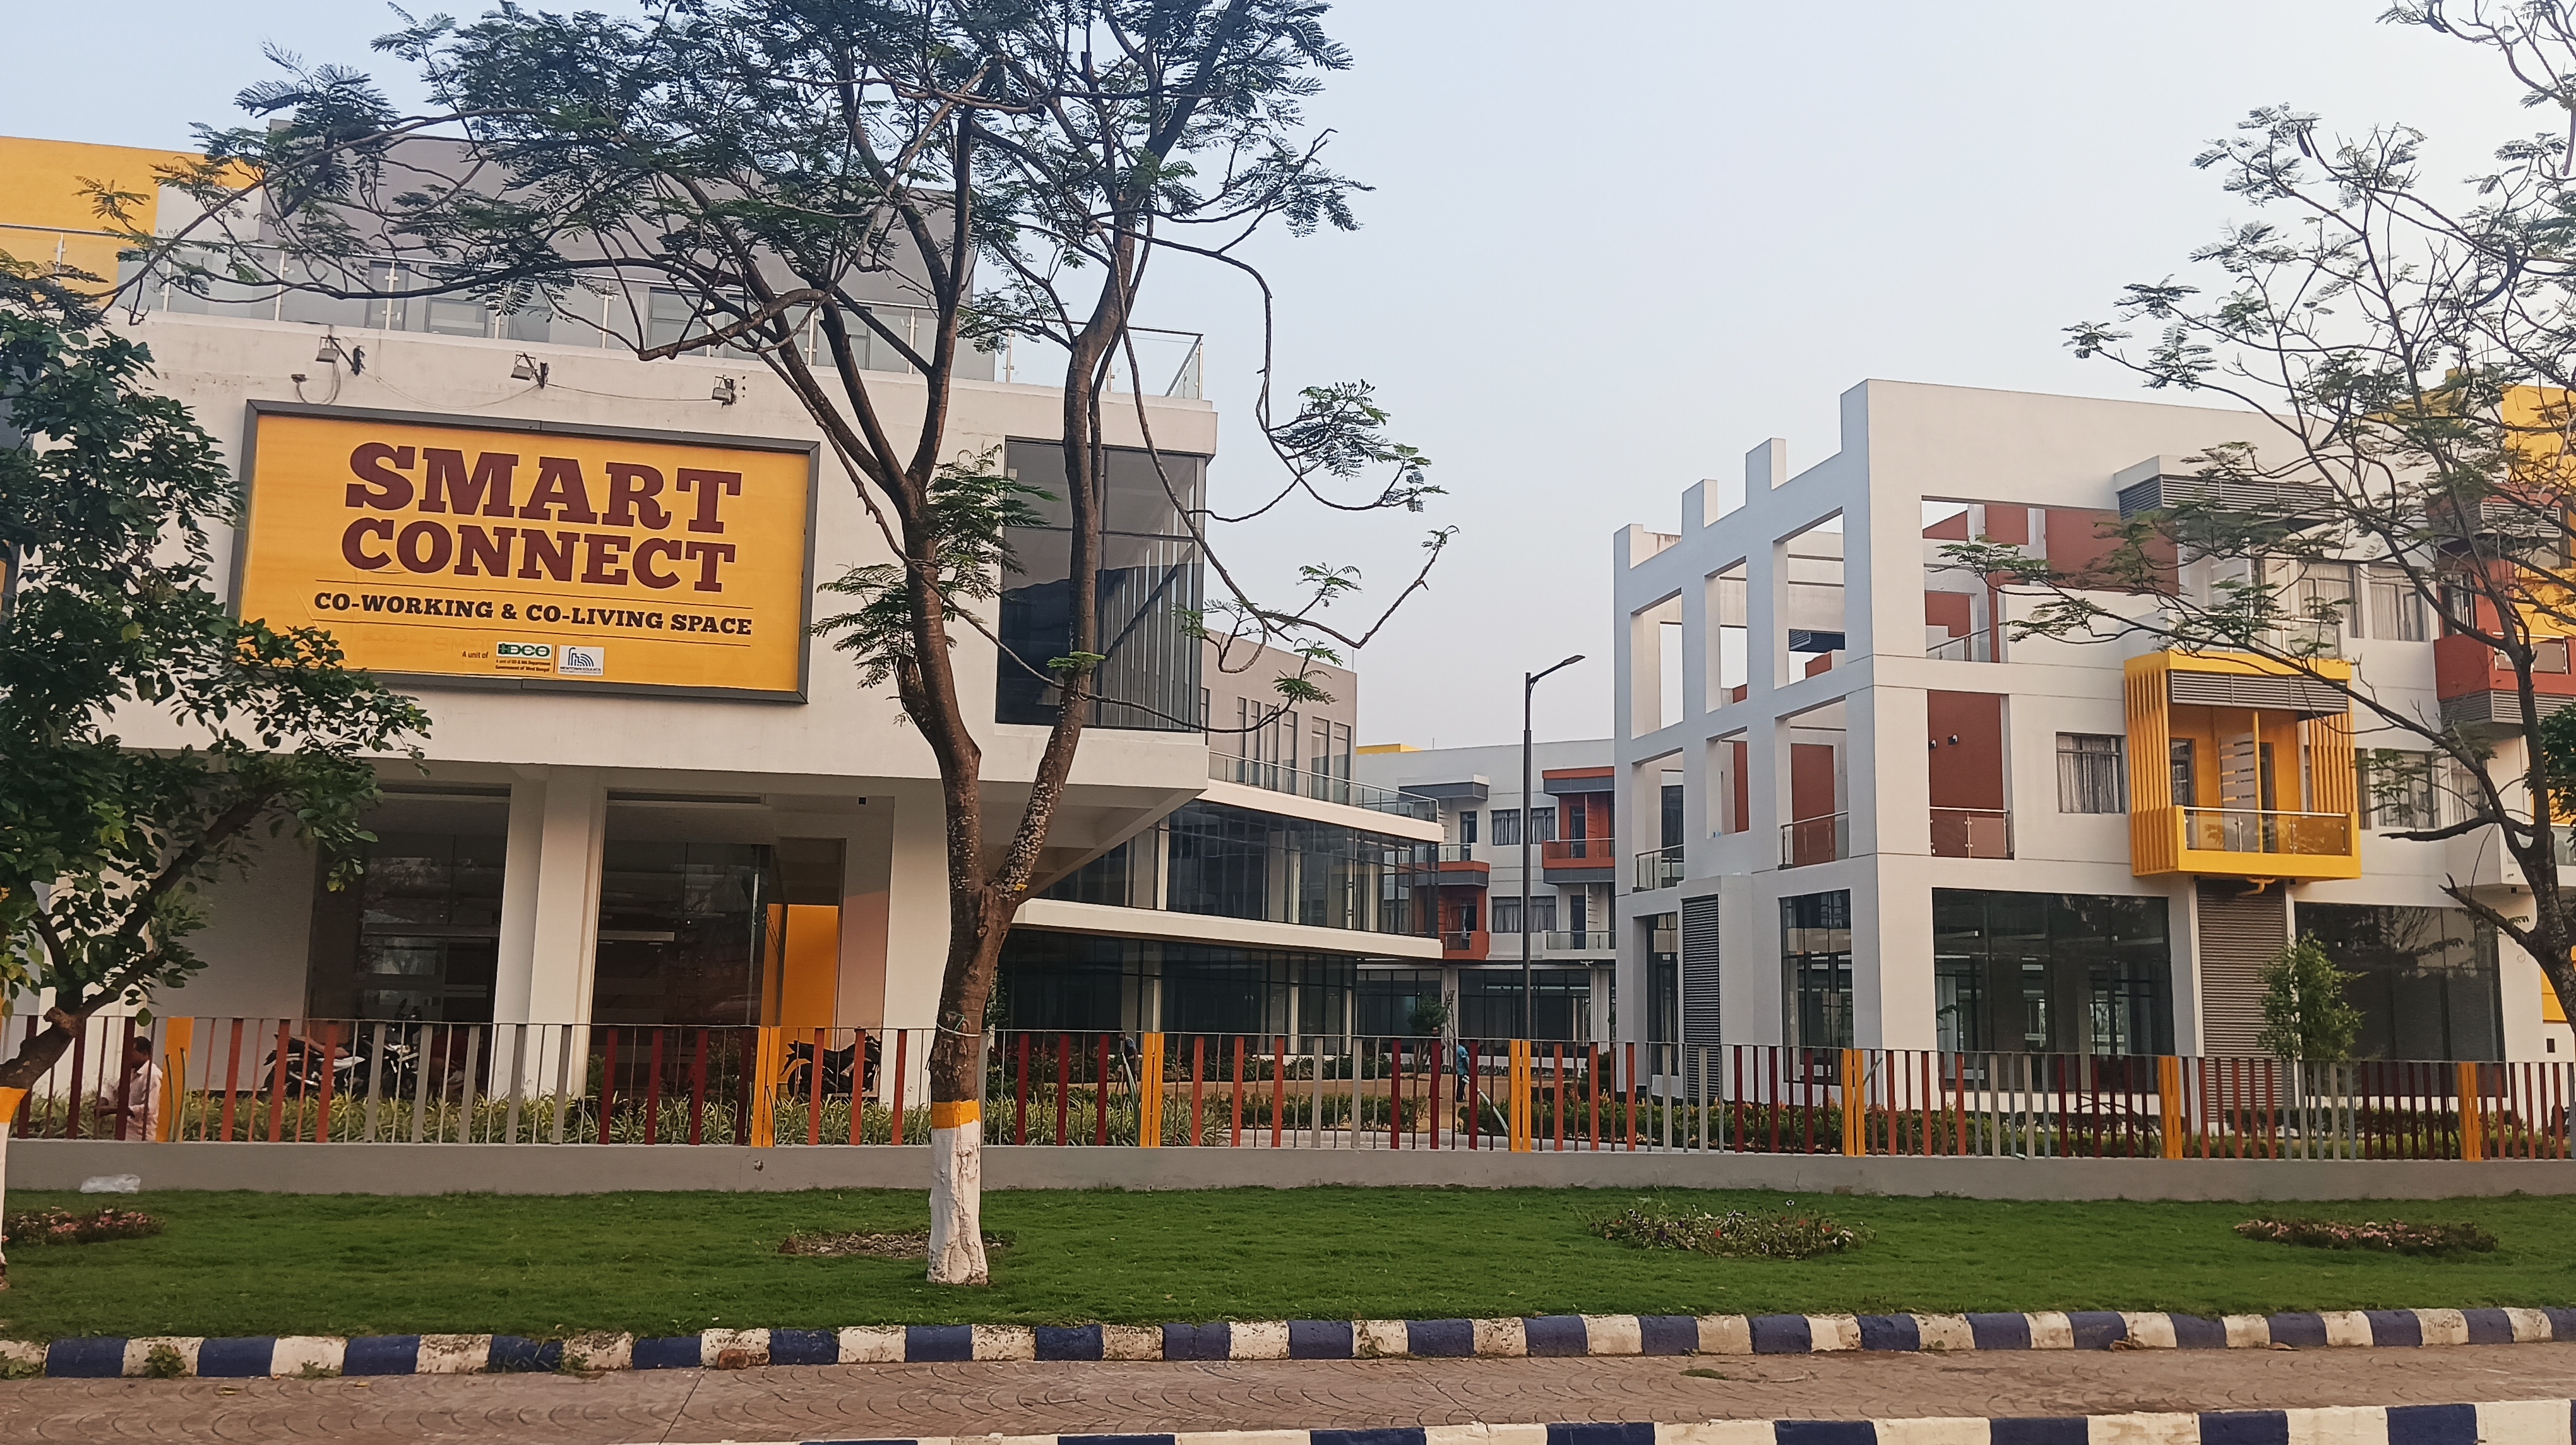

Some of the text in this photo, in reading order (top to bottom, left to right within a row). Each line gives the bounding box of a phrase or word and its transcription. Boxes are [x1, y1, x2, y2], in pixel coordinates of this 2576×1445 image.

[345, 442, 742, 534] SMART
[342, 517, 736, 592] CONNECT
[314, 592, 752, 635] CO-WORKING & CO-LIVING SPACE
[482, 651, 489, 659] of
